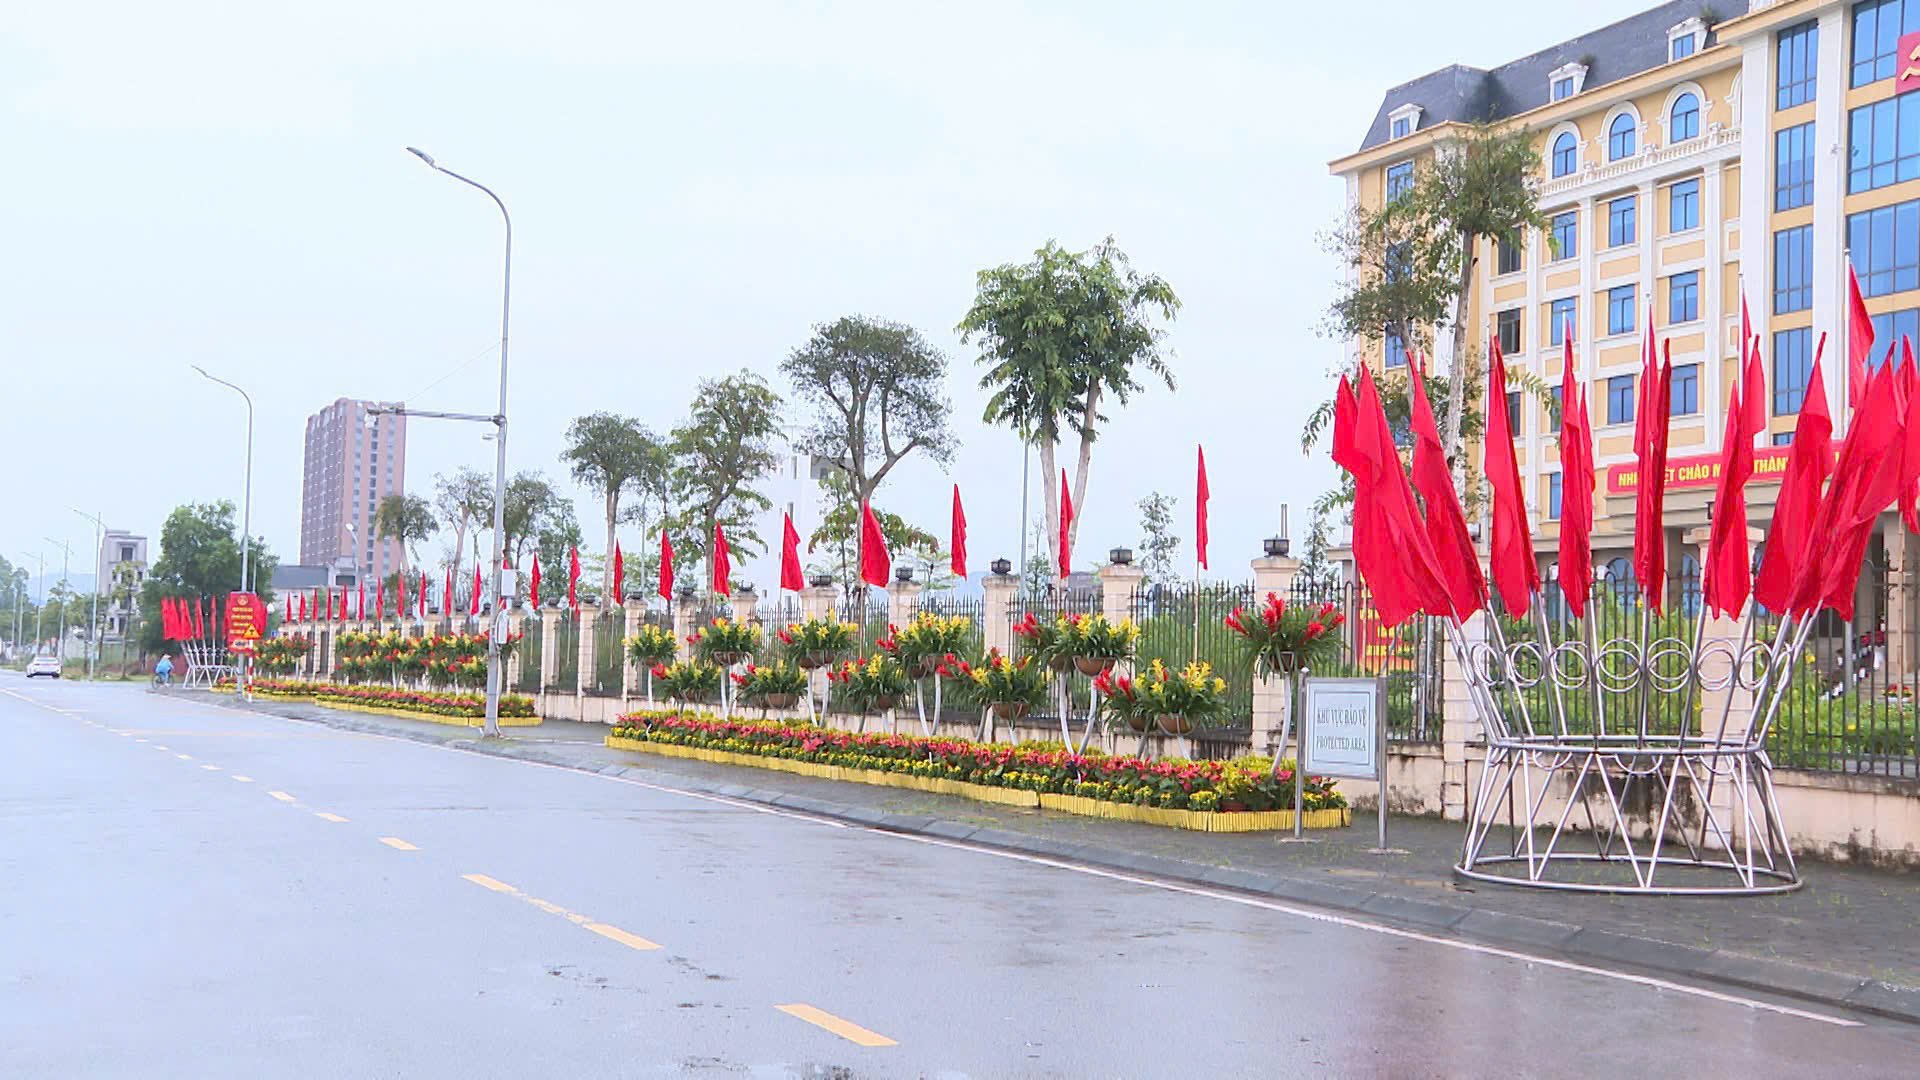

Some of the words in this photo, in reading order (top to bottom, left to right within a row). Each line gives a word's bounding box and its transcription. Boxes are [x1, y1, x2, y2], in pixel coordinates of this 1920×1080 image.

[1618, 471, 1638, 487] NHI
[1678, 463, 1710, 481] CHÀO
[1753, 455, 1789, 474] THÀN
[1317, 706, 1330, 724] KHU
[1344, 704, 1358, 726] BẢO
[1358, 705, 1367, 728] VỆ
[1316, 735, 1350, 751] PROTECTED
[1350, 737, 1366, 752] AREA
